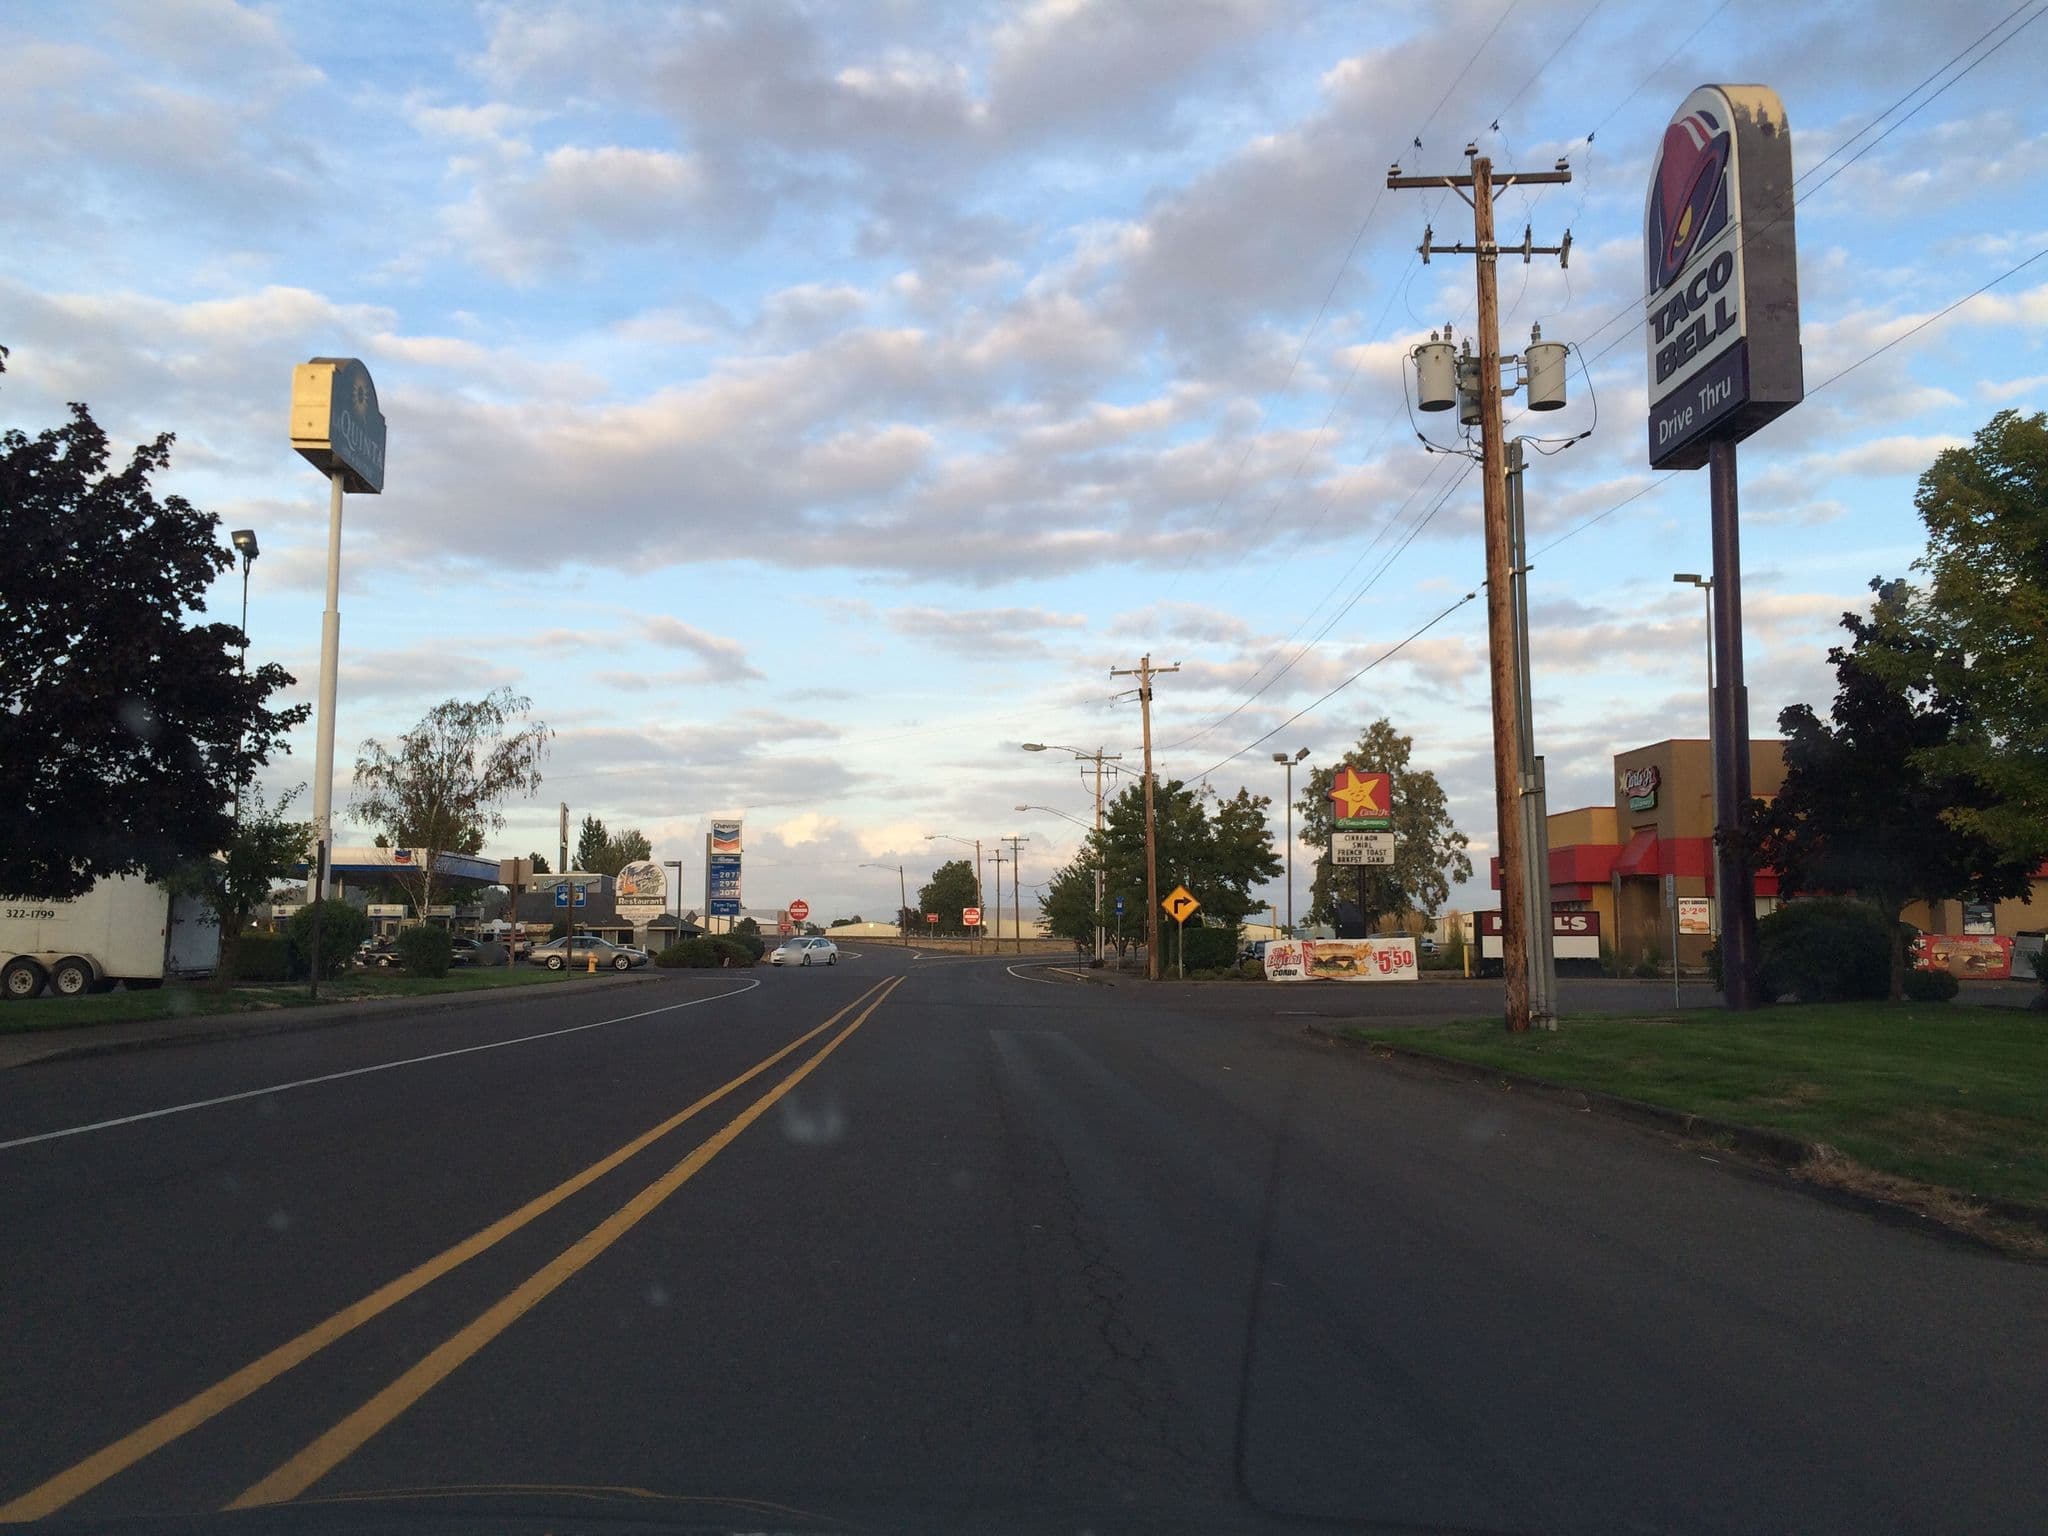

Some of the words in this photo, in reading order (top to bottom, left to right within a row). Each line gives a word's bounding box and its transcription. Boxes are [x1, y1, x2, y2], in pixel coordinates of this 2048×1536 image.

[1649, 250, 1733, 345] TACO
[1656, 297, 1736, 386] BELL
[341, 410, 383, 471] QUINTA
[1658, 403, 1693, 445] Drive
[1698, 376, 1732, 415] Thru
[6, 909, 55, 918] 322-1799
[618, 897, 664, 905] Restaurant
[1272, 969, 1298, 977] COMBO
